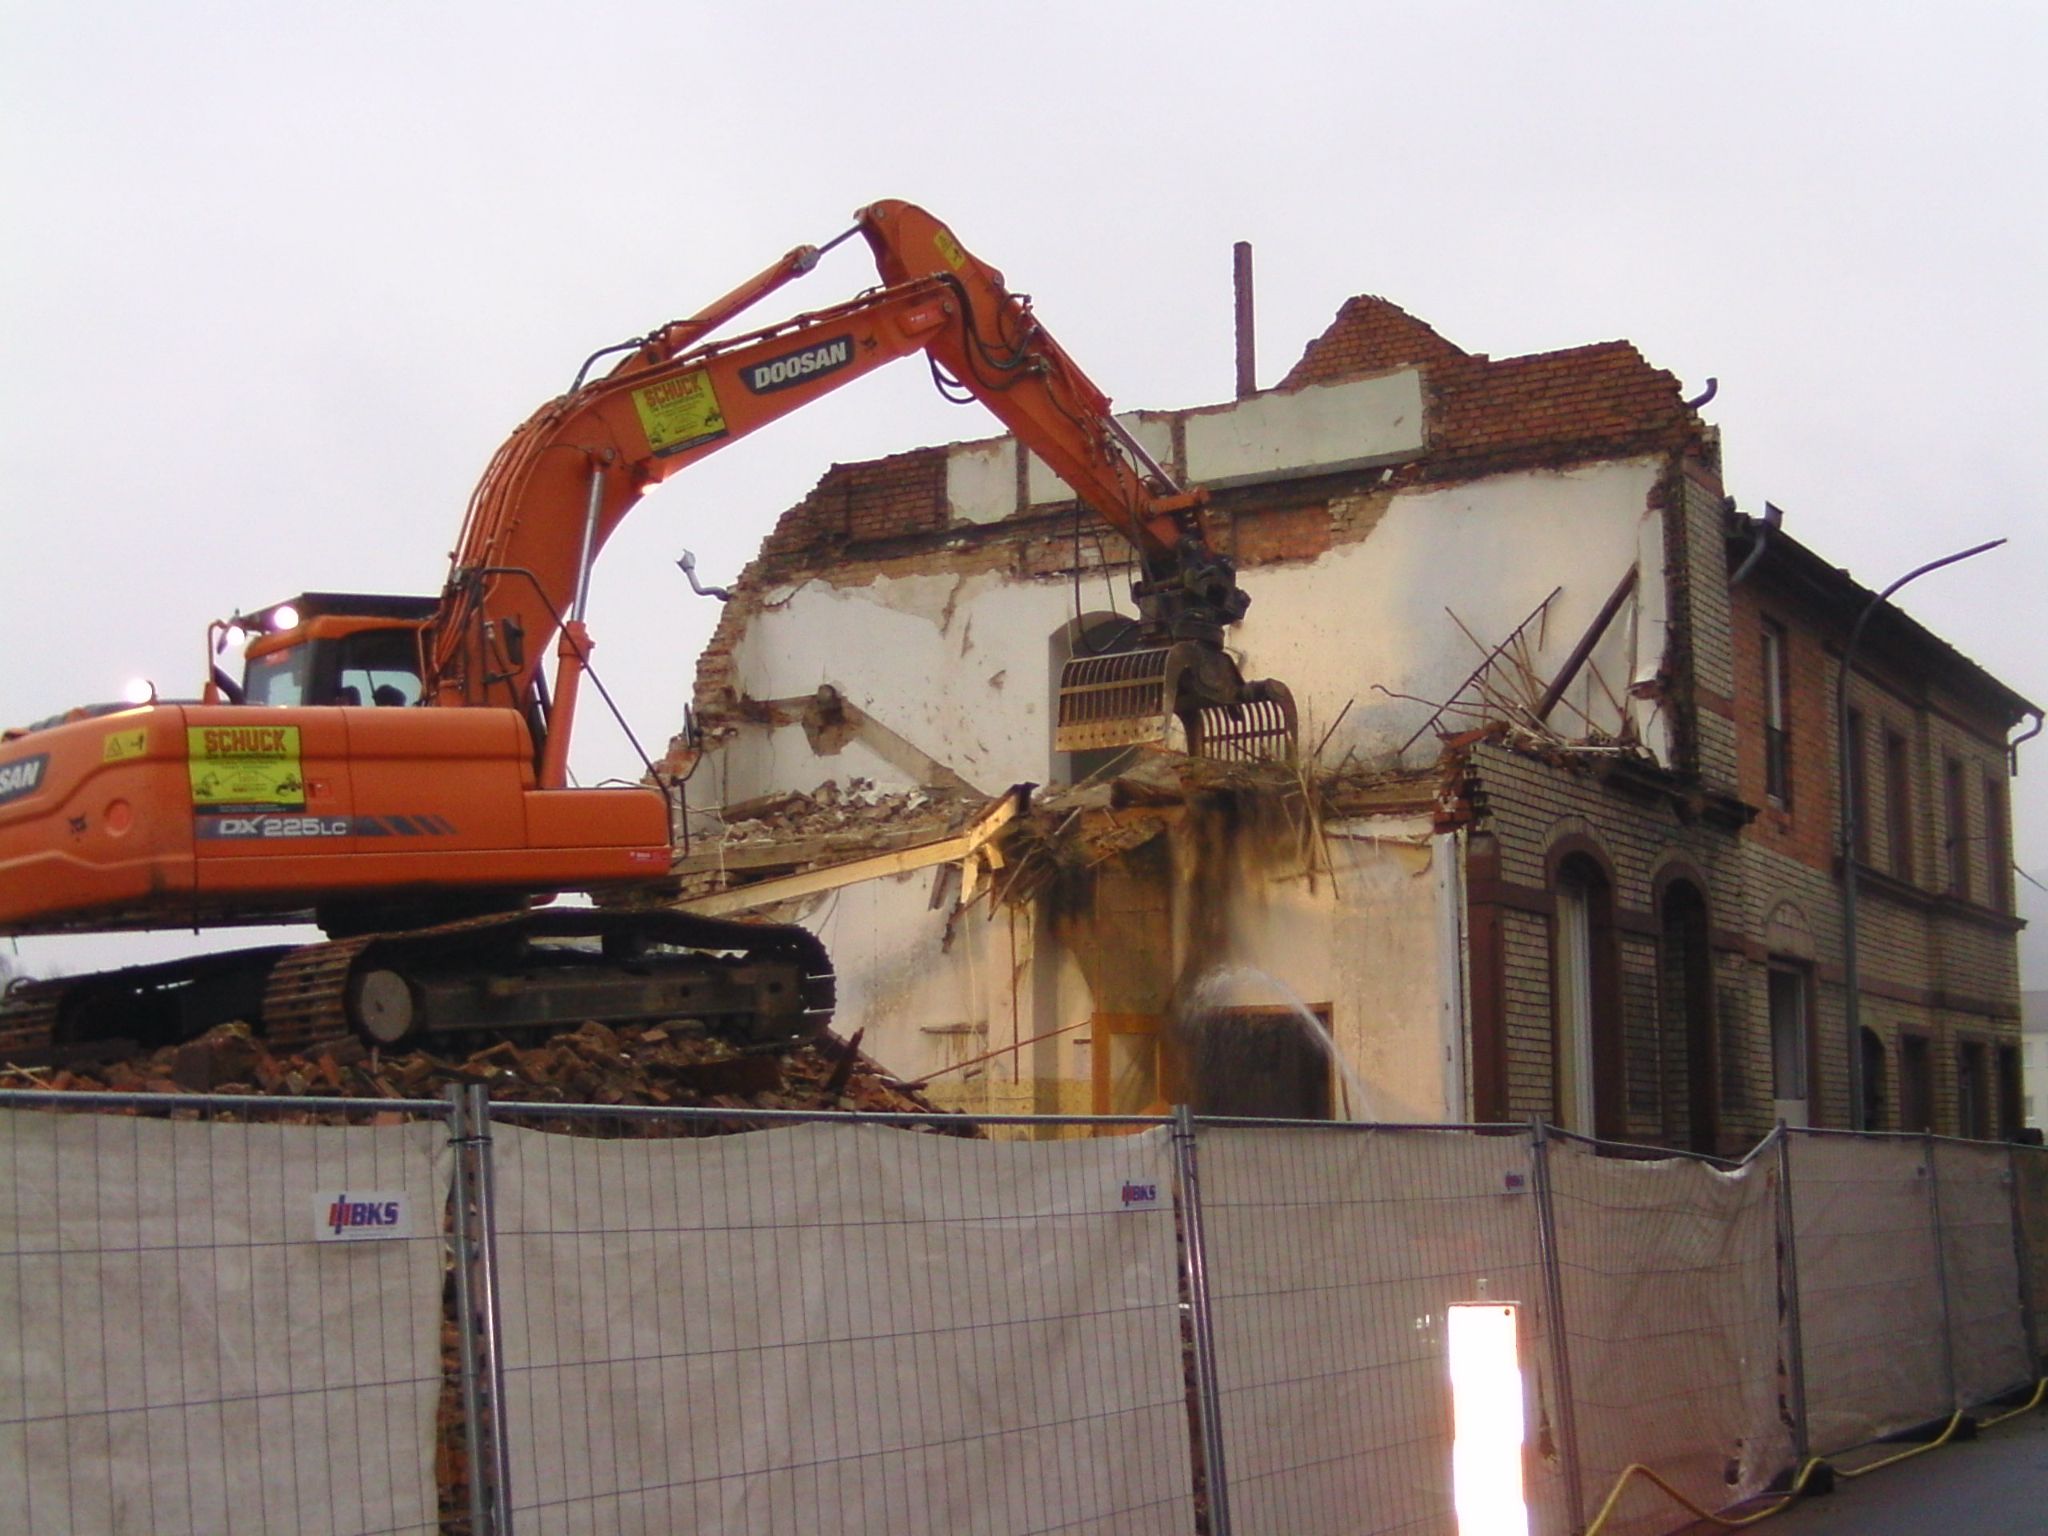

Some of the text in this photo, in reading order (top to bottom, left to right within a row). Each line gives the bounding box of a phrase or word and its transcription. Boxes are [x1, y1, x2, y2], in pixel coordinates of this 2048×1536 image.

[753, 341, 847, 390] DOOSAN
[643, 373, 702, 404] SCHUCK
[203, 729, 287, 752] SCHUCK
[350, 1202, 399, 1226] BKS
